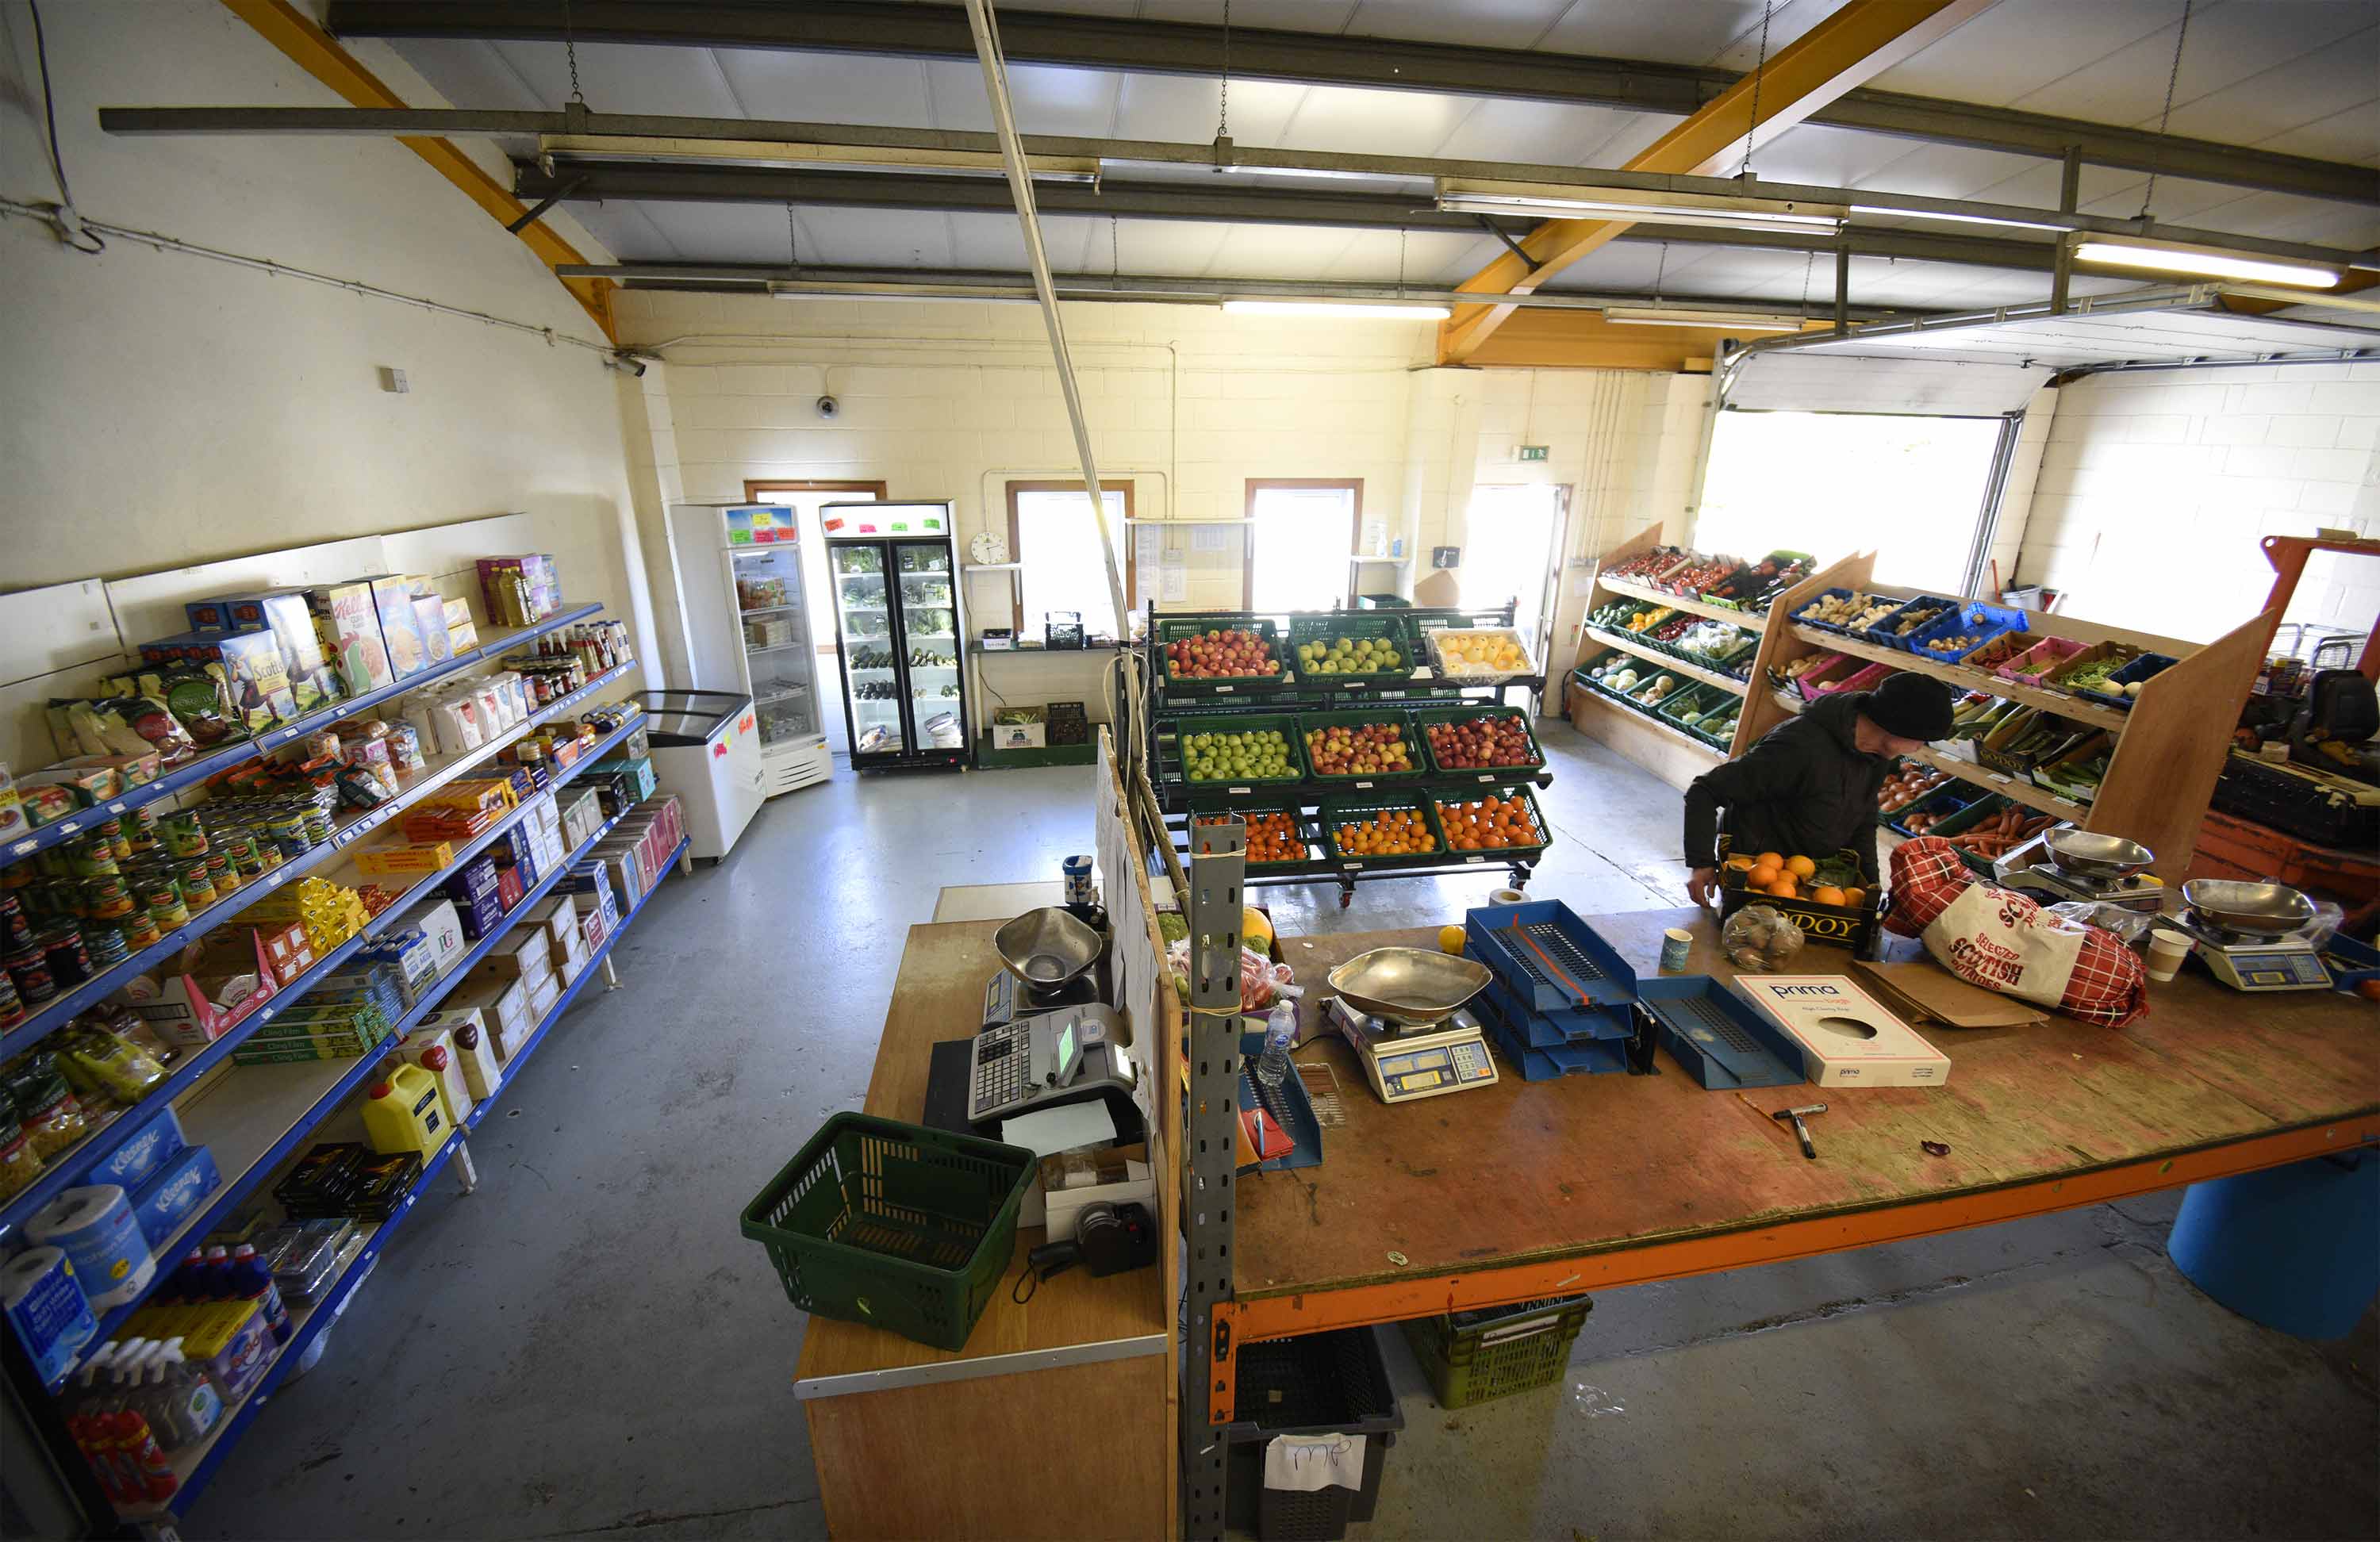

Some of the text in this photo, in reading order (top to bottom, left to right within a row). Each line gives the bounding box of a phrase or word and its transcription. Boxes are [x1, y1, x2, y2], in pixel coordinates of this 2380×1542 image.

[1975, 932, 2020, 961] SELECTED
[1948, 938, 2023, 986] SCOTTISH
[1951, 959, 2002, 990] POTATOES
[1769, 984, 1841, 999] prima
